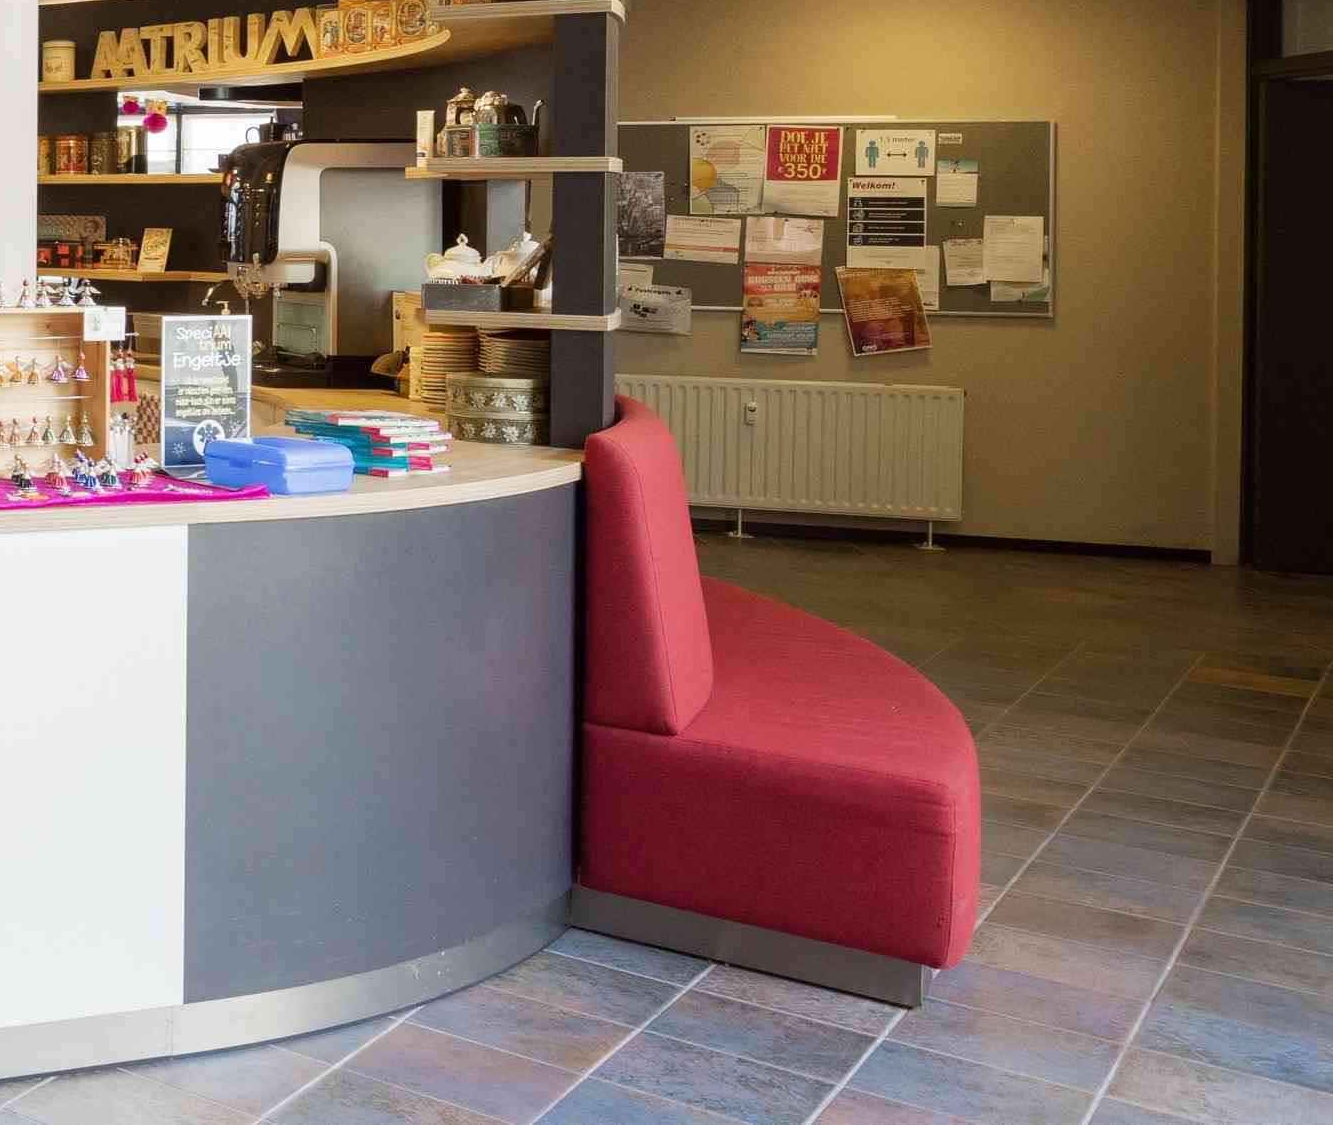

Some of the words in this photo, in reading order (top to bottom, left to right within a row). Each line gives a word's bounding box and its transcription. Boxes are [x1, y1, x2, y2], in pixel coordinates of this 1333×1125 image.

[780, 130, 808, 144] DOE
[810, 131, 829, 144] JE
[804, 143, 828, 155] NIET
[778, 153, 808, 164] VOOR
[810, 153, 828, 164] DIE
[852, 181, 896, 190] Welkom!
